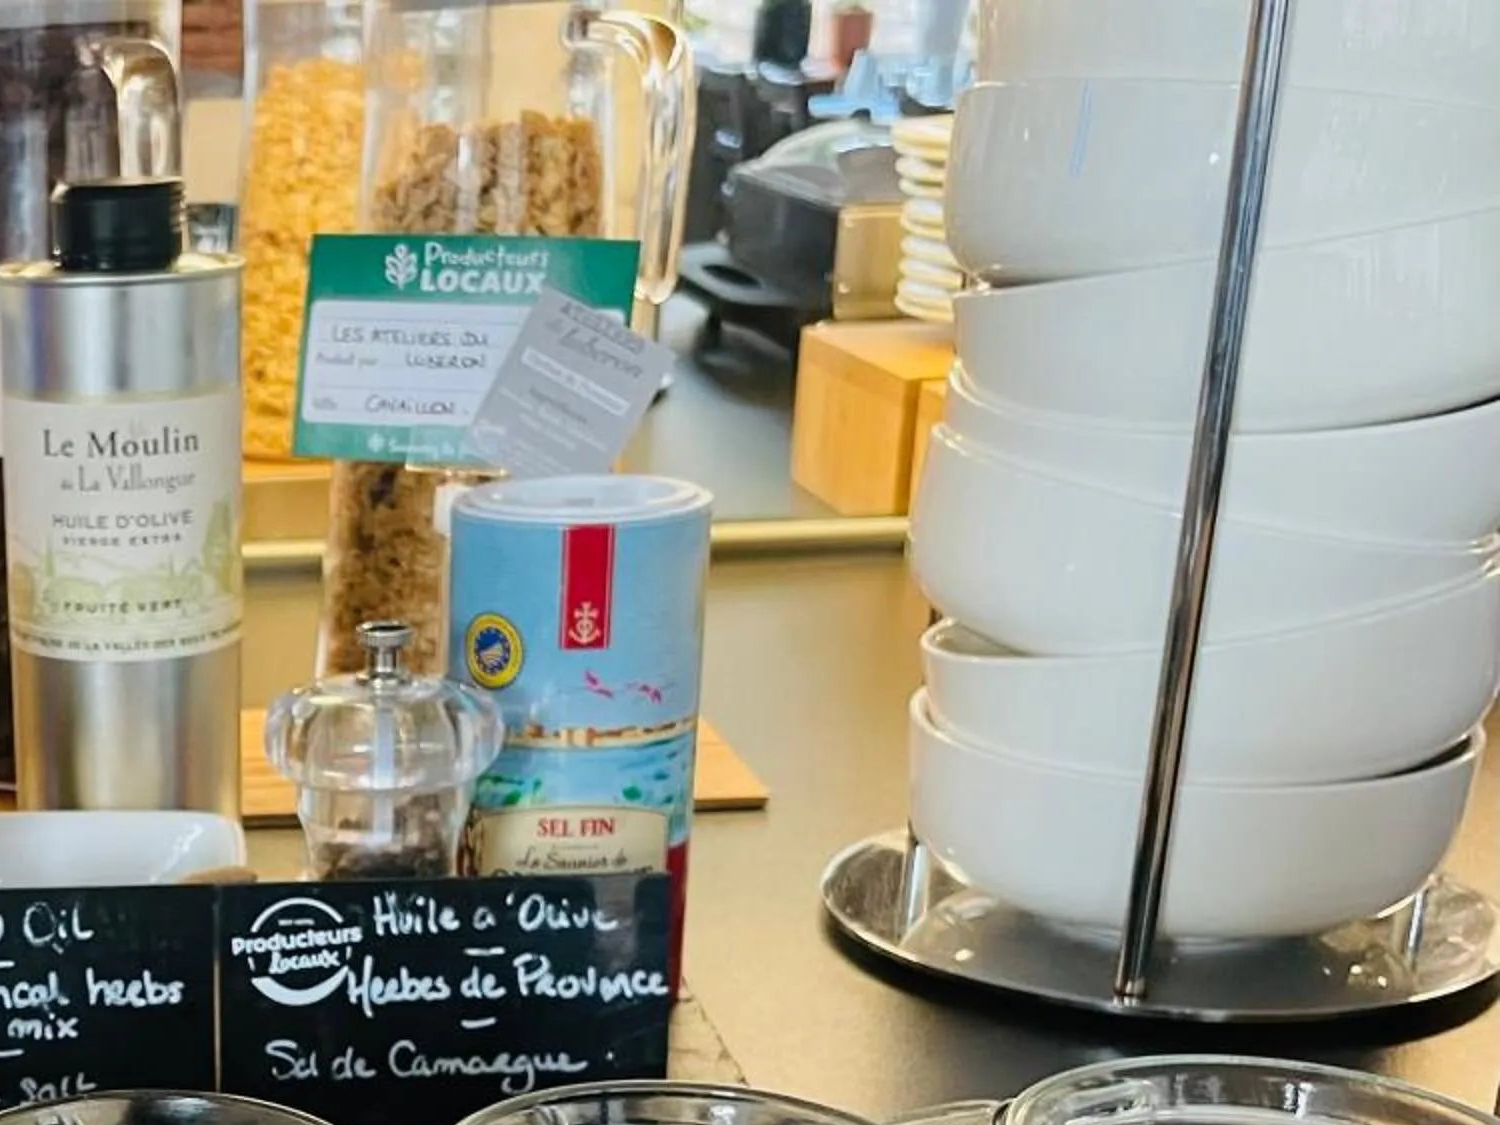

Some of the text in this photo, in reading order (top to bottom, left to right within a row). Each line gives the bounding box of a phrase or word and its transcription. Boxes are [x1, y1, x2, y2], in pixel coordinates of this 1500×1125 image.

[425, 241, 550, 268] Producteurs
[421, 268, 546, 295] LOCAUX
[43, 426, 200, 457] Le Moulin
[78, 464, 100, 492] La
[107, 462, 196, 494] Vallongue
[51, 508, 194, 530] HUILE D'OLIVE
[536, 816, 615, 837] SEL FIN
[373, 891, 461, 935] Huile
[232, 925, 363, 955] Producteurs
[347, 955, 450, 1017] Herbes
[460, 966, 506, 1000] de
[7, 1011, 79, 1041] mix
[265, 1039, 318, 1080] Sel
[332, 1047, 375, 1079] de
